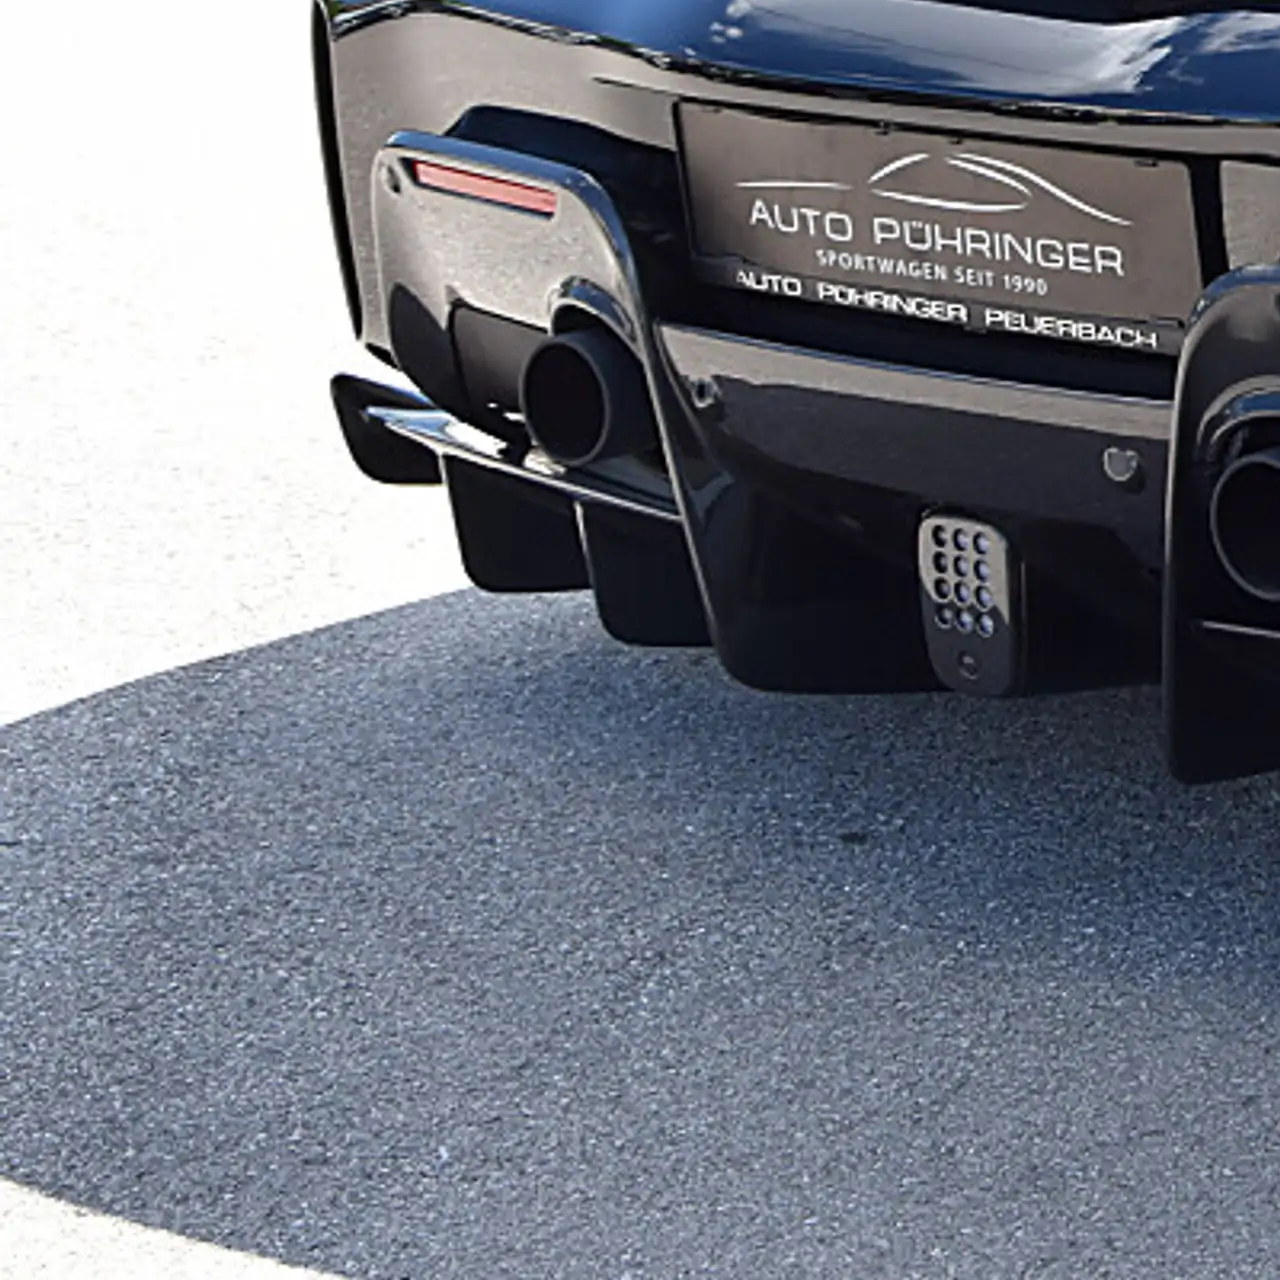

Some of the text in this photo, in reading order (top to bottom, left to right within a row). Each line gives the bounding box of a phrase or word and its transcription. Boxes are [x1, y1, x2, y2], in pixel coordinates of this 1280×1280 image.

[748, 199, 1125, 278] AUTO PÜHRINGER
[815, 250, 1049, 297] SPORTWAGEN SEIT 1990
[735, 270, 803, 297] AUTO
[984, 307, 1158, 350] PEUERBACH
